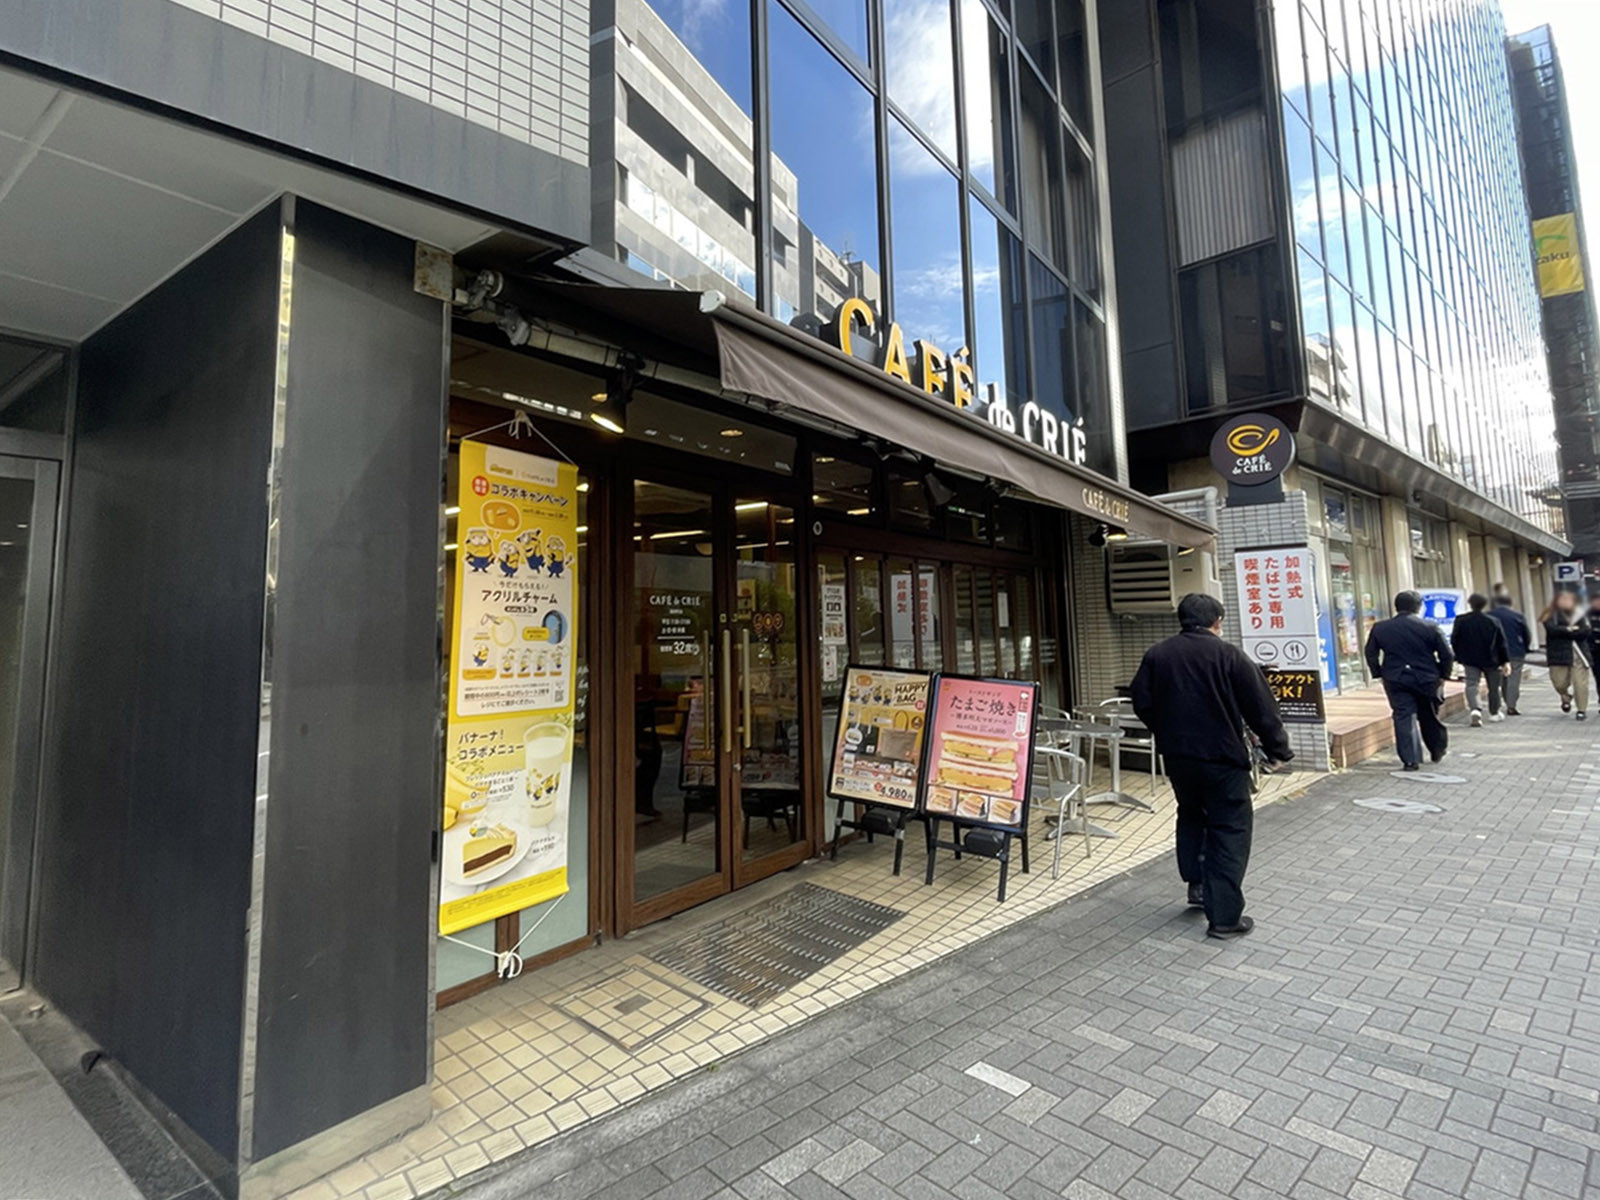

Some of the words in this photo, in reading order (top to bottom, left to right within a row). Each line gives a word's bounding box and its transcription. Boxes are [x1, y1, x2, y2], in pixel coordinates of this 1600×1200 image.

[839, 298, 974, 409] CAFÉ
[989, 383, 1016, 434] de
[1021, 401, 1087, 466] CRIÉ
[1285, 556, 1304, 600] 加熱式
[1558, 566, 1575, 579] P
[481, 590, 558, 605] アクリルチャーム
[1243, 558, 1264, 631] 喫煙室あり
[1264, 557, 1285, 630] たばこ専用
[950, 696, 1016, 717] たまご焼き
[459, 745, 524, 760] コラボメニュー
